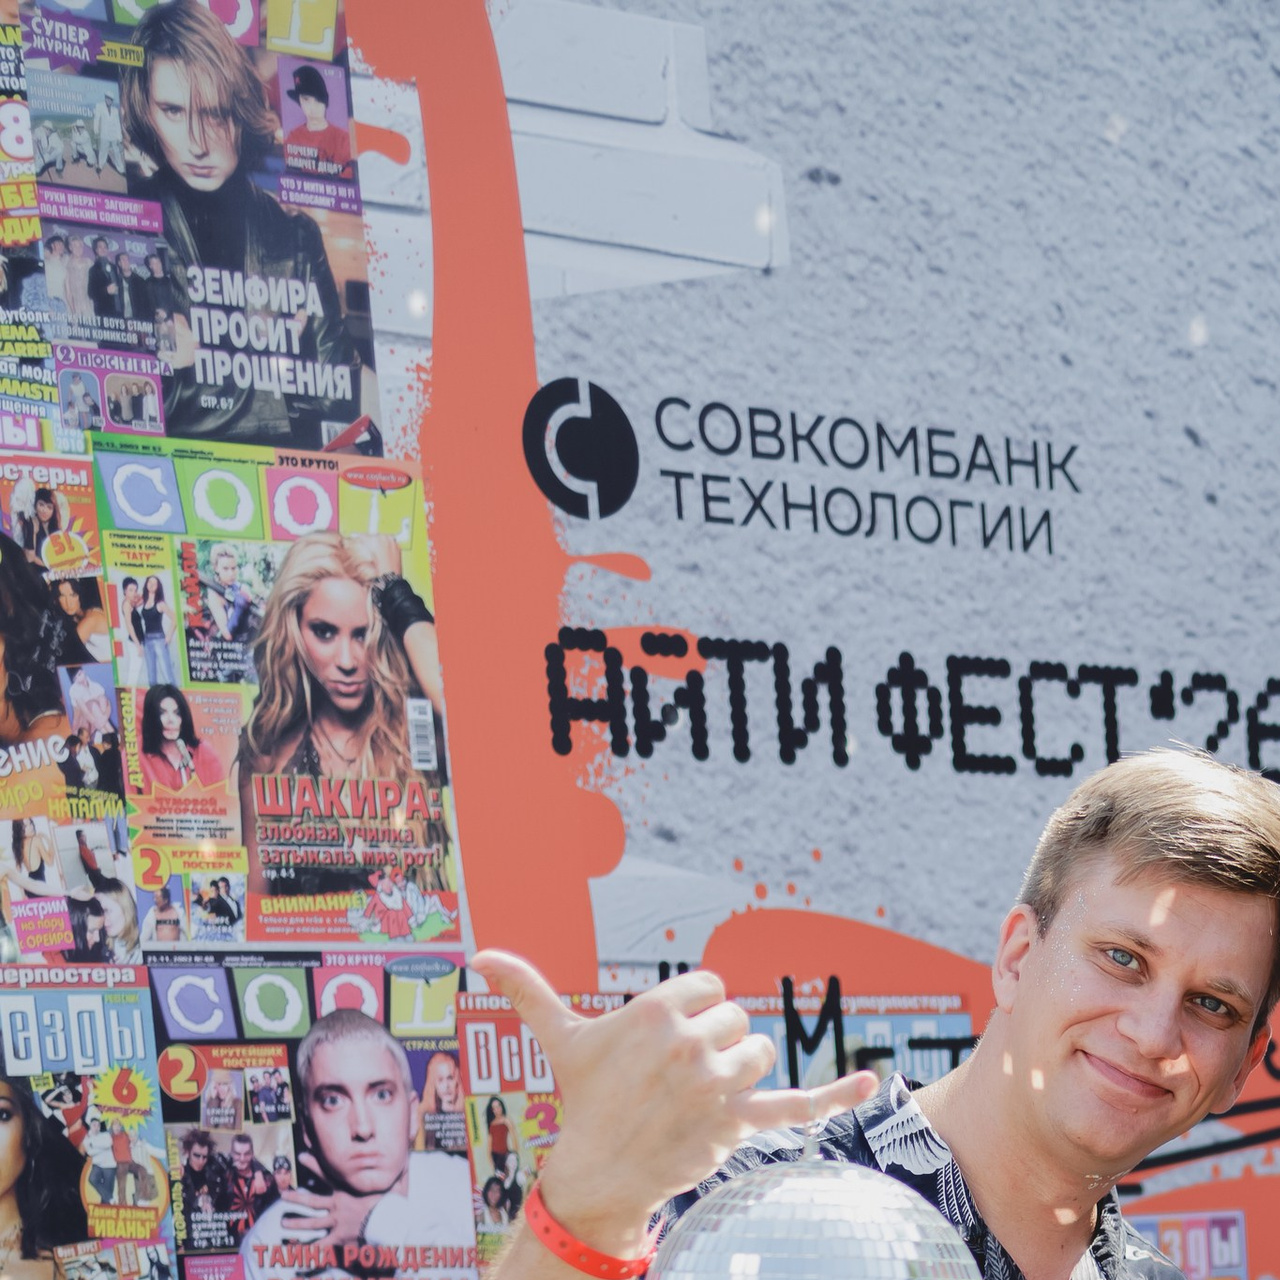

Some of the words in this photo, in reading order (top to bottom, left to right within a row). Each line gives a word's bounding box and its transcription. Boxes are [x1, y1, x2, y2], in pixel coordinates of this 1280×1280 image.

[31, 17, 90, 45] СУПЕР
[32, 34, 90, 62] ЖУРНАЛ
[186, 265, 325, 319] ЗЕМФИРА
[92, 329, 139, 345] КОМИКСОВ
[103, 316, 126, 331] BOYS
[190, 306, 303, 356] ПРОСИТ
[194, 347, 354, 402] ПРОЩЕНИЯ
[277, 455, 299, 469] ЭТО
[301, 457, 339, 472] КРУТО!
[653, 395, 1083, 495] СОВКОМБАНК
[658, 468, 1056, 556] ТЕХНОЛОГИИ
[544, 625, 850, 767] АЙТИ
[254, 773, 443, 821] ШАКИРА:
[257, 818, 341, 844] злобная
[343, 824, 415, 848] училка
[139, 848, 164, 885] 2
[258, 846, 355, 867] затыкала
[361, 848, 398, 867] мне
[402, 844, 444, 871] рот!
[112, 1066, 139, 1106] 6
[167, 1048, 199, 1095] 2
[89, 1218, 158, 1240] "ИВАНЫ"
[252, 1239, 338, 1268] ТАЙНА
[343, 1245, 479, 1272] РОЖДЕНИЯ
